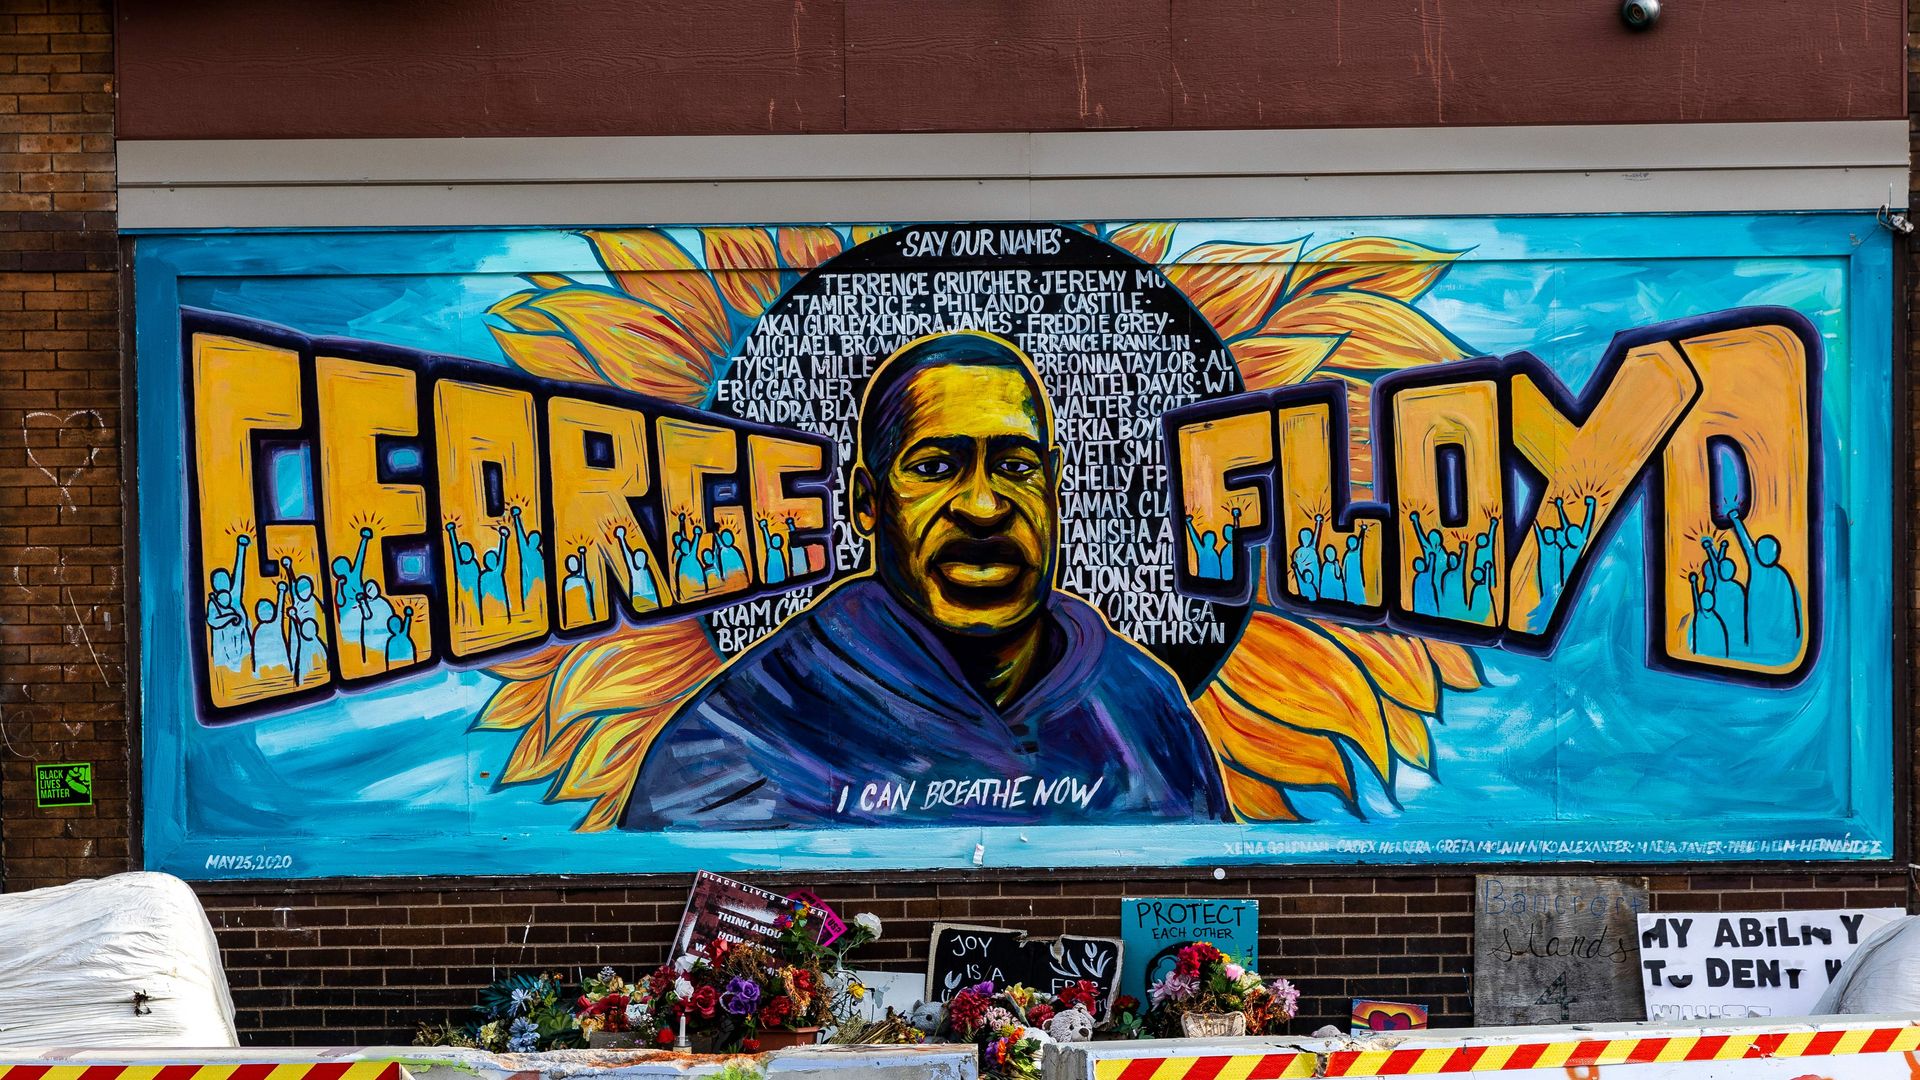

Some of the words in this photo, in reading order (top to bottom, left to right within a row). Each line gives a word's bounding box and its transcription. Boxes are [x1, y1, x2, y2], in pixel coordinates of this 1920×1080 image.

[902, 230, 949, 257] SAY
[951, 229, 997, 256] OUR
[1001, 228, 1062, 255] NAMES
[819, 272, 929, 296] TERRENCE
[934, 271, 1033, 295] CRUTCHER
[1040, 269, 1126, 294] JEREMY
[793, 294, 862, 316] TAMIR
[862, 294, 912, 316] RICE
[934, 293, 1044, 315] PHILANDO
[1063, 292, 1144, 314] CASTILE
[755, 314, 799, 336] AKAI
[945, 311, 1012, 334] JAMES
[1027, 313, 1110, 334] FREDDIE
[1115, 312, 1169, 335] GREY
[746, 336, 836, 357] MICHAEL
[1015, 332, 1099, 353] TERRANCE
[1103, 333, 1190, 352] FRANKLIN
[731, 356, 804, 380] TYISHA
[811, 356, 876, 379] MILLE
[1033, 353, 1124, 375] BREONNA
[1121, 352, 1198, 373] TAYLOR
[1204, 349, 1232, 371] AL
[717, 379, 763, 401] ERIC
[766, 379, 855, 401] GARNER
[1044, 374, 1135, 397] SHANTEL
[1137, 373, 1195, 395] DAVIS
[732, 400, 815, 423] SANDRA
[820, 401, 858, 421] BLA
[1050, 395, 1134, 418] WALTER
[1054, 418, 1113, 441] REKIA
[1057, 440, 1120, 466] YVETT
[1121, 440, 1160, 466] SMI
[1061, 464, 1135, 492] SHELLY
[188, 328, 838, 712] GEORGE
[1174, 322, 1811, 671] FLOYD
[1058, 491, 1133, 520] JAMAR
[1060, 518, 1152, 544] TANISHA
[1061, 542, 1139, 566] TARIKA
[1061, 564, 1129, 594] ALTON
[717, 627, 771, 652] BRI
[1119, 621, 1226, 645] KATHRYN
[40, 770, 64, 780] BLACK
[40, 780, 61, 789] LIVES
[40, 789, 70, 799] MATTER
[837, 785, 849, 813] I
[860, 781, 916, 812] CAN
[920, 776, 1033, 810] BREATHE
[1032, 776, 1104, 808] NOW
[1224, 842, 1265, 855] XENA
[1379, 840, 1430, 854] HERRERA
[1436, 839, 1475, 854] GRETA
[702, 872, 737, 889] BLACK
[742, 885, 776, 901] LIVES
[717, 911, 750, 930] THINK
[751, 922, 785, 939] ABOU
[1137, 902, 1246, 928] PROTECT
[950, 935, 993, 957] JOY
[1152, 928, 1186, 940] EACH
[1193, 927, 1235, 940] OTHER
[1642, 918, 1694, 948] MY
[967, 965, 981, 979] IS
[991, 967, 1005, 982] A
[1705, 957, 1806, 989] DENY
[1534, 971, 1579, 1021] 4
